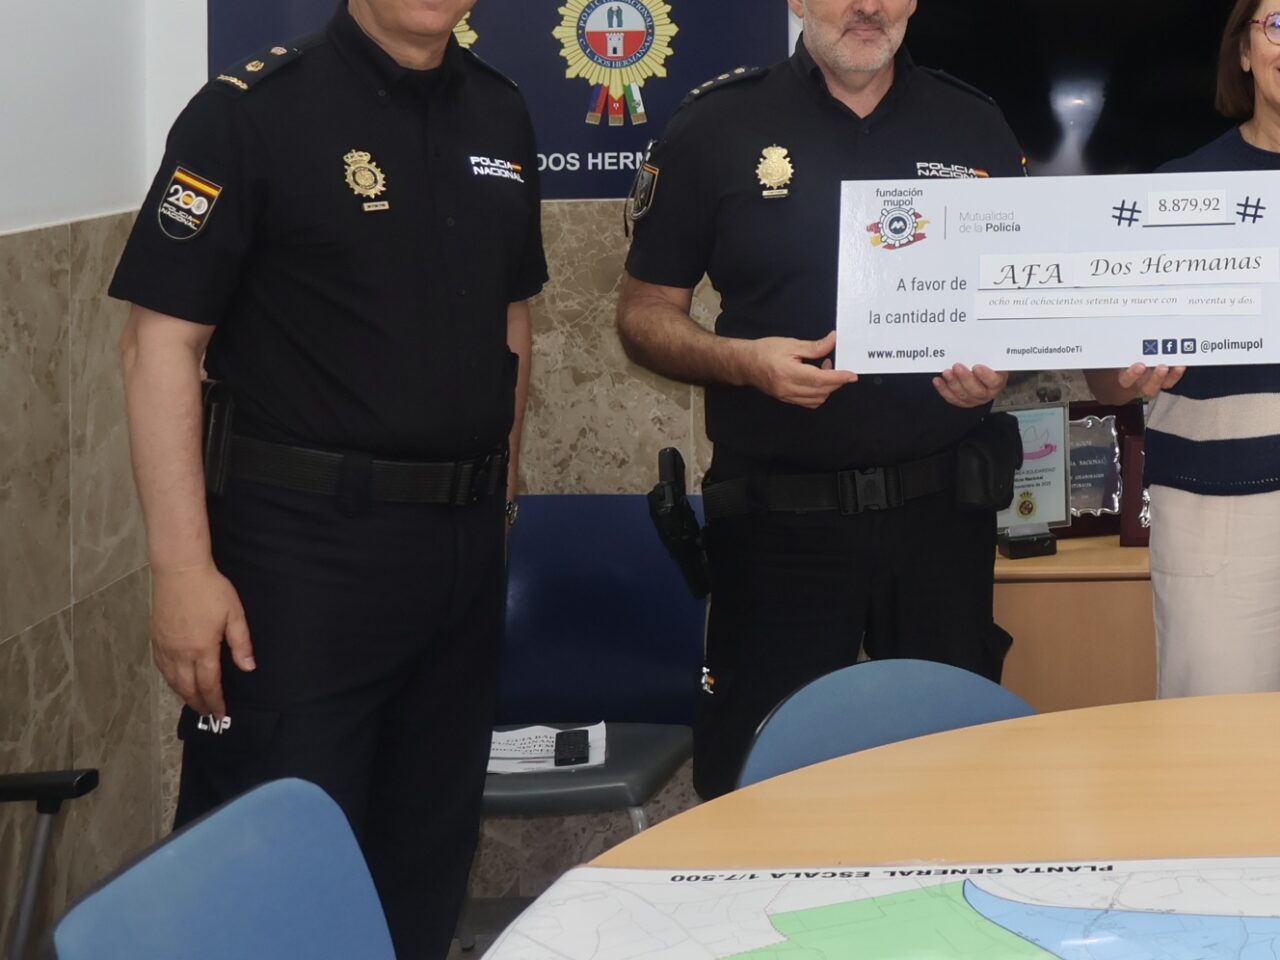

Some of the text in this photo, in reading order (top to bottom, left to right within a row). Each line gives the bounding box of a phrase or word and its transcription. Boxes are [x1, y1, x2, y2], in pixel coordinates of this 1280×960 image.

[473, 166, 525, 183] NACIONAL
[917, 169, 978, 180] NACION
[876, 188, 923, 198] fundación
[883, 196, 914, 208] mupol
[1158, 197, 1221, 213] 8.879,92
[959, 212, 1015, 222] Mutualidad
[959, 222, 1021, 233] de la Policía
[993, 253, 1262, 290] AFA Dos Hermanas
[897, 276, 967, 291] A favor de
[989, 296, 1010, 306] ocho
[1012, 296, 1028, 306] mil
[1030, 296, 1083, 306] ochocientos
[1086, 296, 1119, 305] setenta
[1121, 297, 1128, 307] y
[1130, 296, 1158, 305] nueve
[1161, 296, 1177, 304] con
[1188, 296, 1226, 305] noventa
[1229, 297, 1236, 307] y
[869, 308, 967, 324] la cantidad de
[1006, 345, 1082, 356] #mupolCuidandoDeTi
[1200, 338, 1263, 353] @polimupol
[868, 347, 945, 360] www.mupol.es
[670, 864, 1114, 883] PLANTA GENERAL ESCALA 1/7.500
